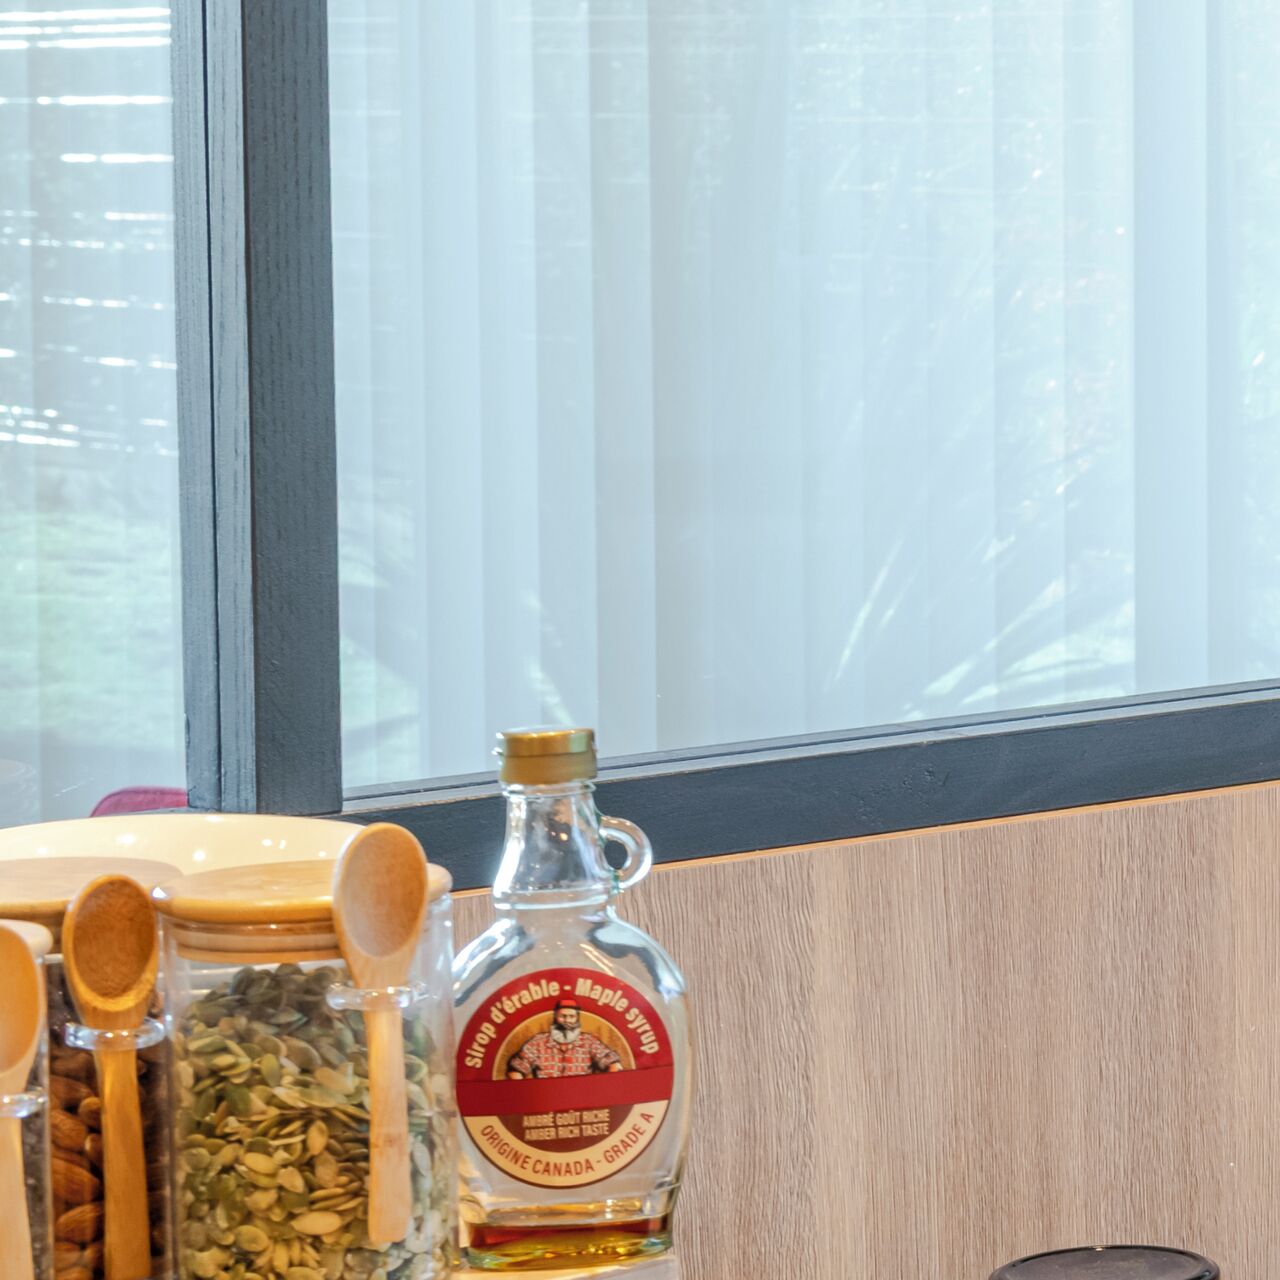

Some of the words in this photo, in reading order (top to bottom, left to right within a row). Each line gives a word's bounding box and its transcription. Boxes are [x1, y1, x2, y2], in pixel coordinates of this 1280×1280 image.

[464, 1022, 497, 1069] Sirop
[490, 979, 560, 1024] d'érable
[574, 977, 629, 1012] Maple
[625, 1007, 660, 1055] syrup
[524, 1127, 557, 1142] AMBER
[557, 1125, 580, 1138] RICH
[581, 1122, 610, 1137] TASTE
[582, 1108, 611, 1122] RICHE
[480, 1125, 531, 1170] ORIGINE
[532, 1158, 595, 1177] CANADA
[603, 1123, 646, 1164] GRADE
[640, 1111, 655, 1124] A
